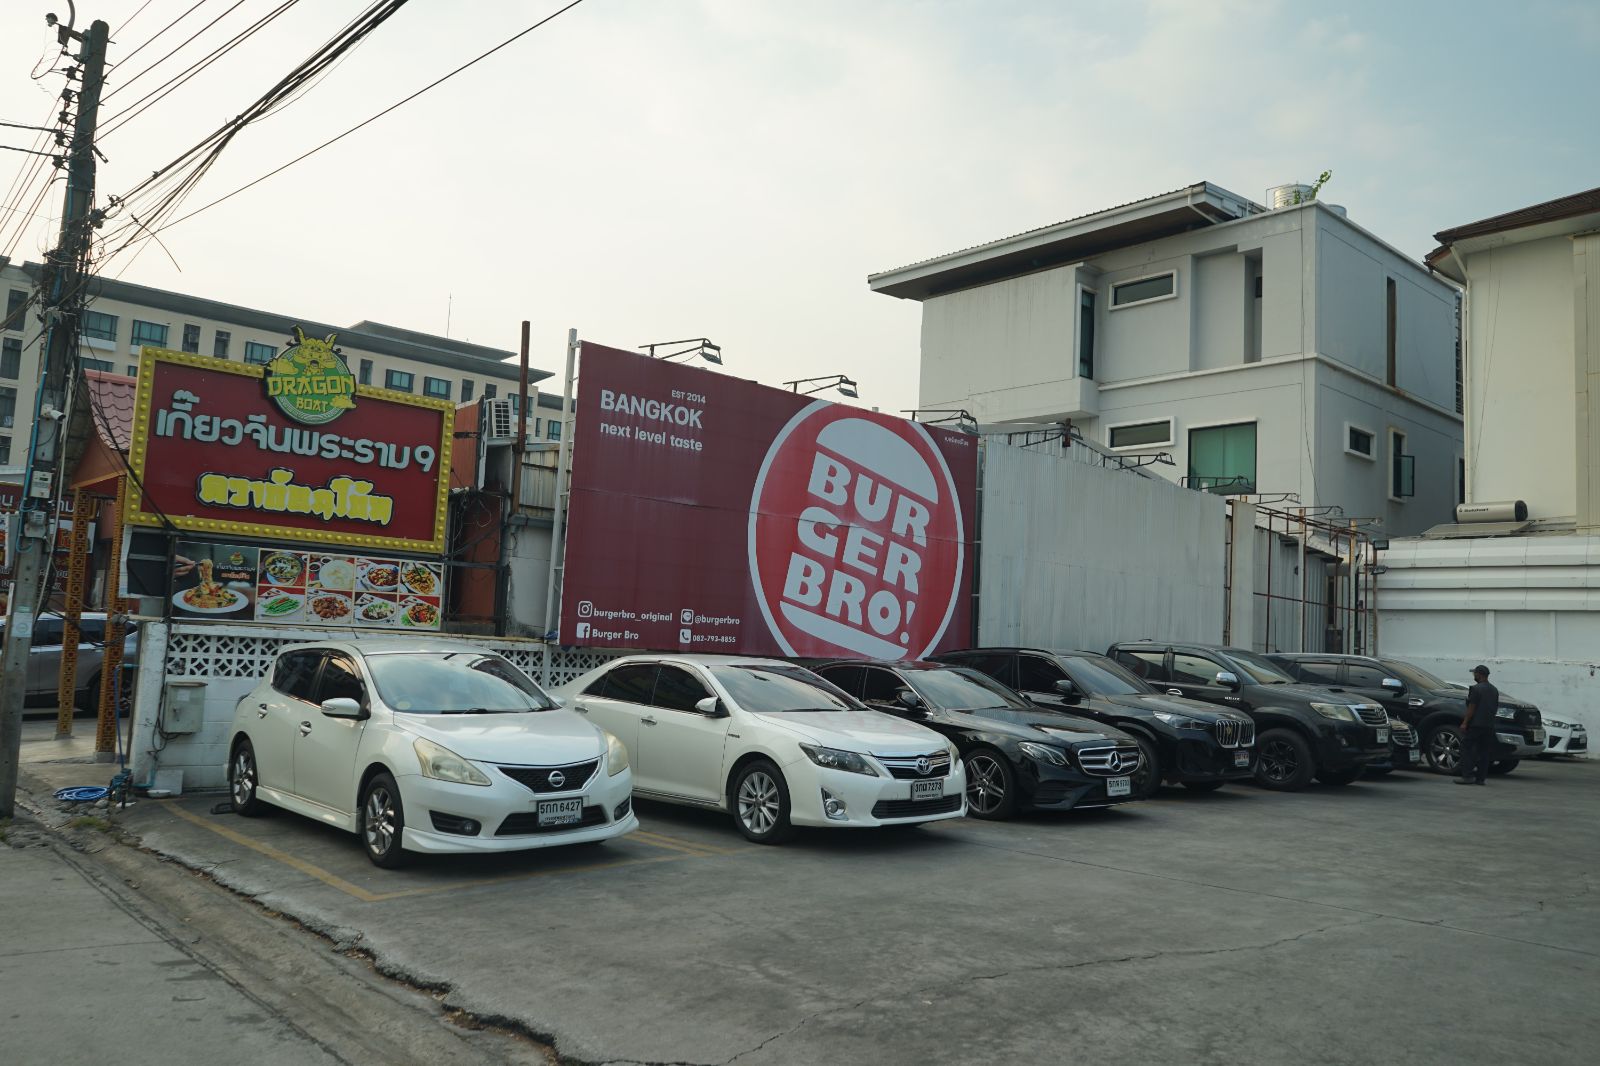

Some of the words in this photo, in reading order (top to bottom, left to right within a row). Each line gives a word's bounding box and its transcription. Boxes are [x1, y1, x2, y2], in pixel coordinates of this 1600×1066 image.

[267, 375, 355, 396] DRAGON
[671, 389, 685, 400] EST
[687, 392, 706, 404] 2014
[296, 397, 328, 412] BOAT
[600, 389, 703, 429] BANGKOK
[600, 422, 631, 438] next
[634, 427, 666, 445] level
[670, 434, 703, 451] taste
[807, 451, 930, 548] BUR
[797, 506, 922, 595] GER
[782, 551, 916, 644] BRO!
[593, 607, 673, 622] burgerbro_original
[694, 614, 741, 626] @burgerbro
[592, 628, 622, 639] Burger
[624, 629, 639, 640] Bro
[692, 635, 736, 643] 082-793-8855
[928, 781, 942, 791] 7273
[560, 801, 580, 812] 6427
